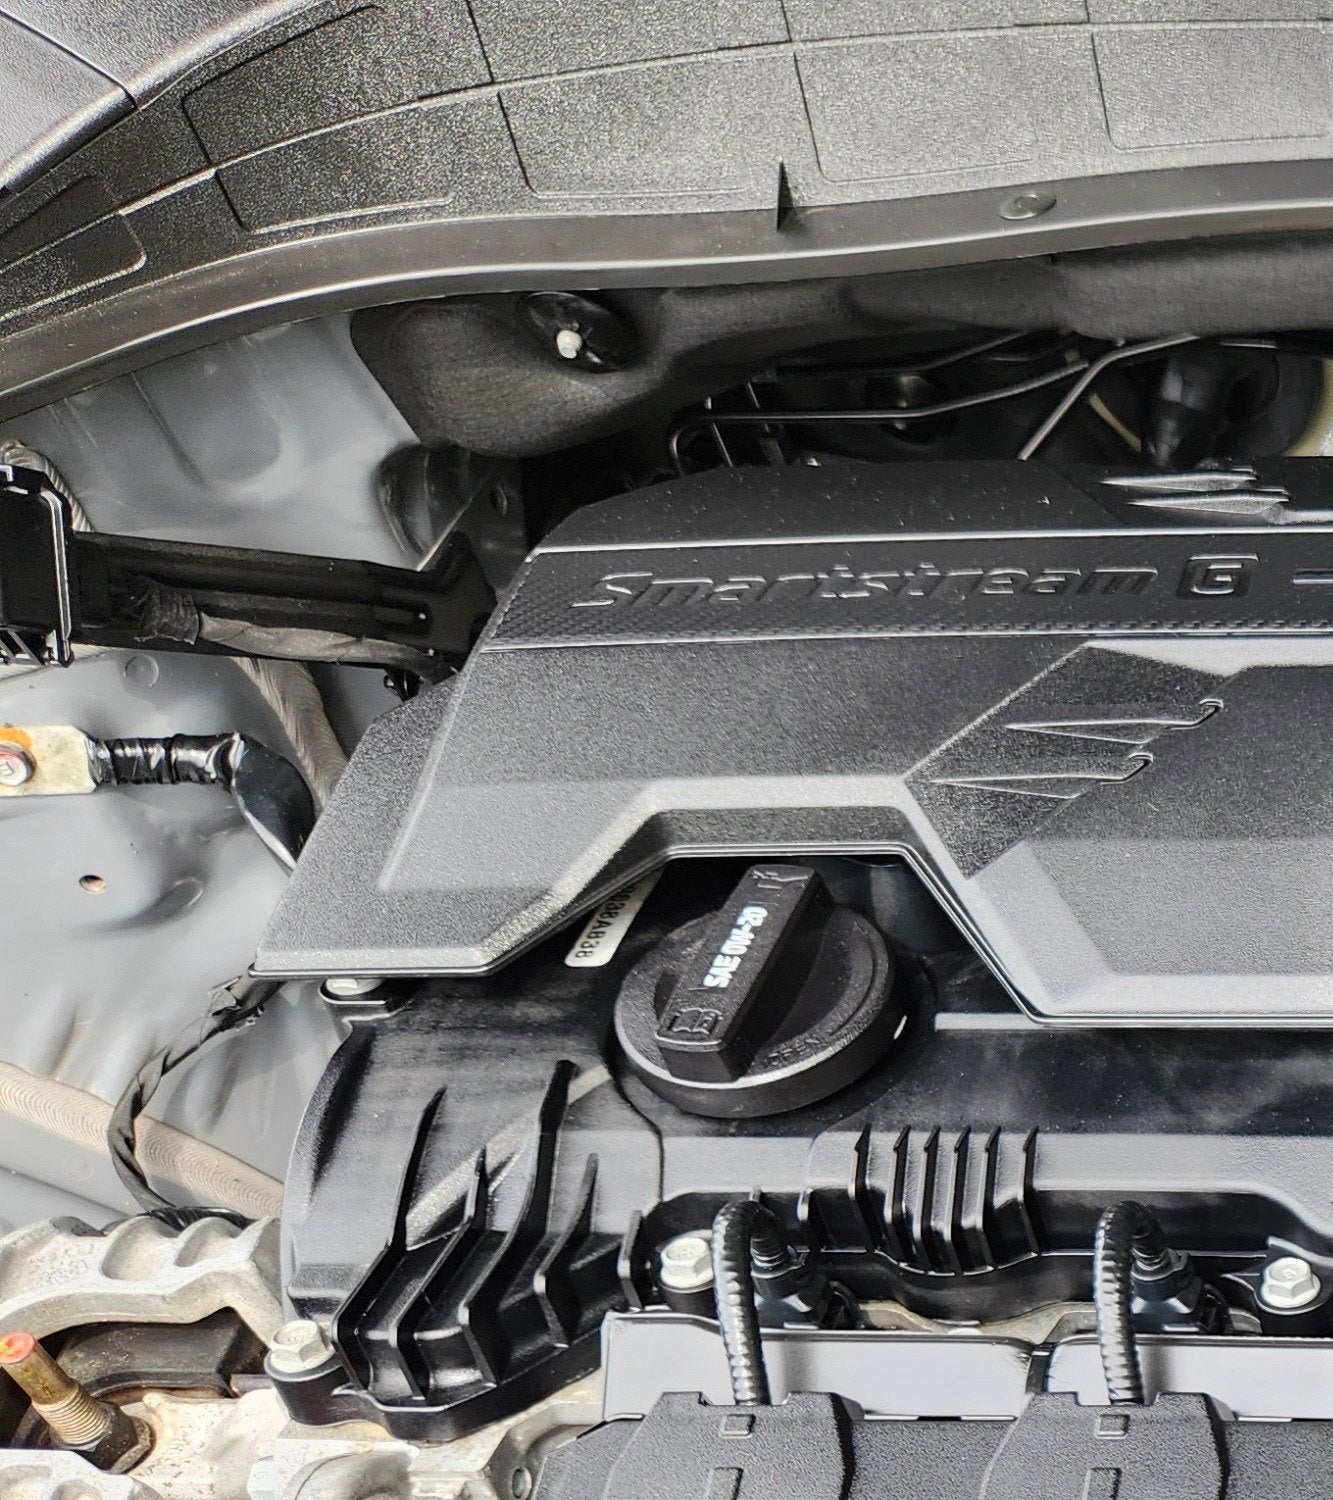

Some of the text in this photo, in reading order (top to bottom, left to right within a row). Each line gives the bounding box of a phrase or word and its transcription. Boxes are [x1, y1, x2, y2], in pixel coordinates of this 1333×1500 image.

[572, 563, 1158, 608] Smartstream
[703, 905, 768, 988] SAE 0W-20
